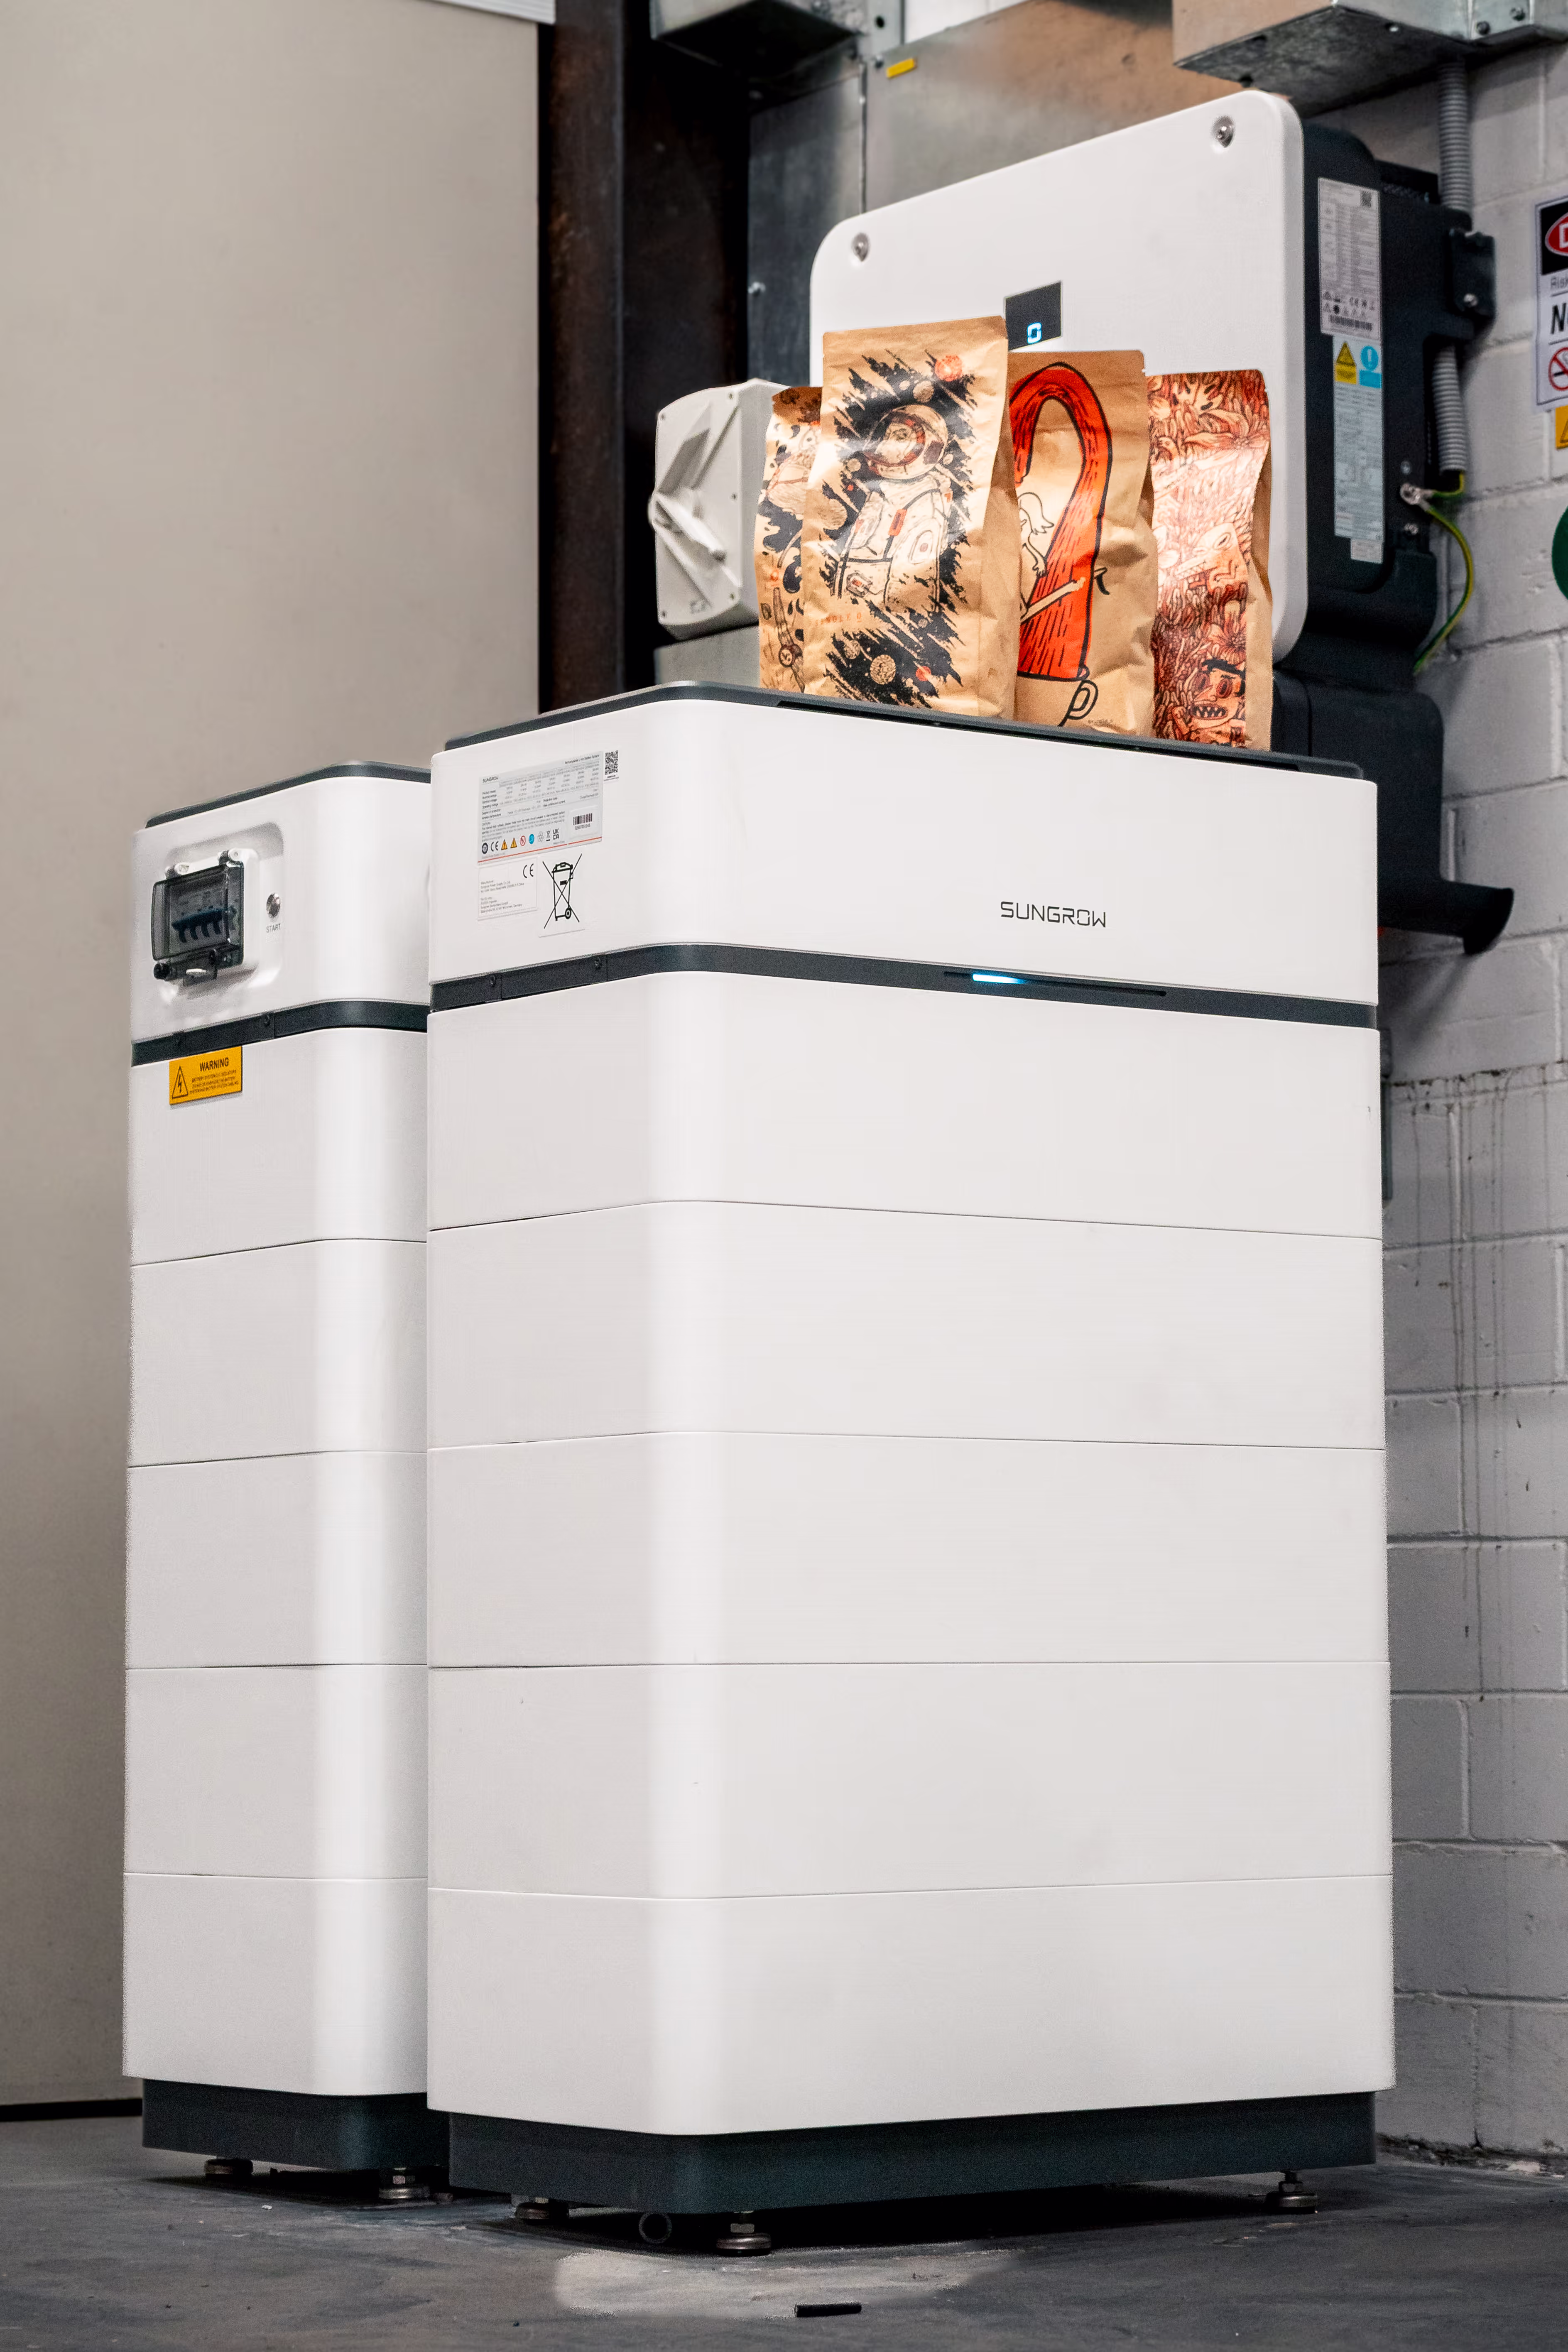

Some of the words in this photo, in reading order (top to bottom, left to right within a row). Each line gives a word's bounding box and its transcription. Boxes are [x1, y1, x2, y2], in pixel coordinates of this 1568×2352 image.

[1001, 901, 1106, 928] SUNGROW
[266, 923, 281, 933] START
[199, 1057, 229, 1071] WARNING
